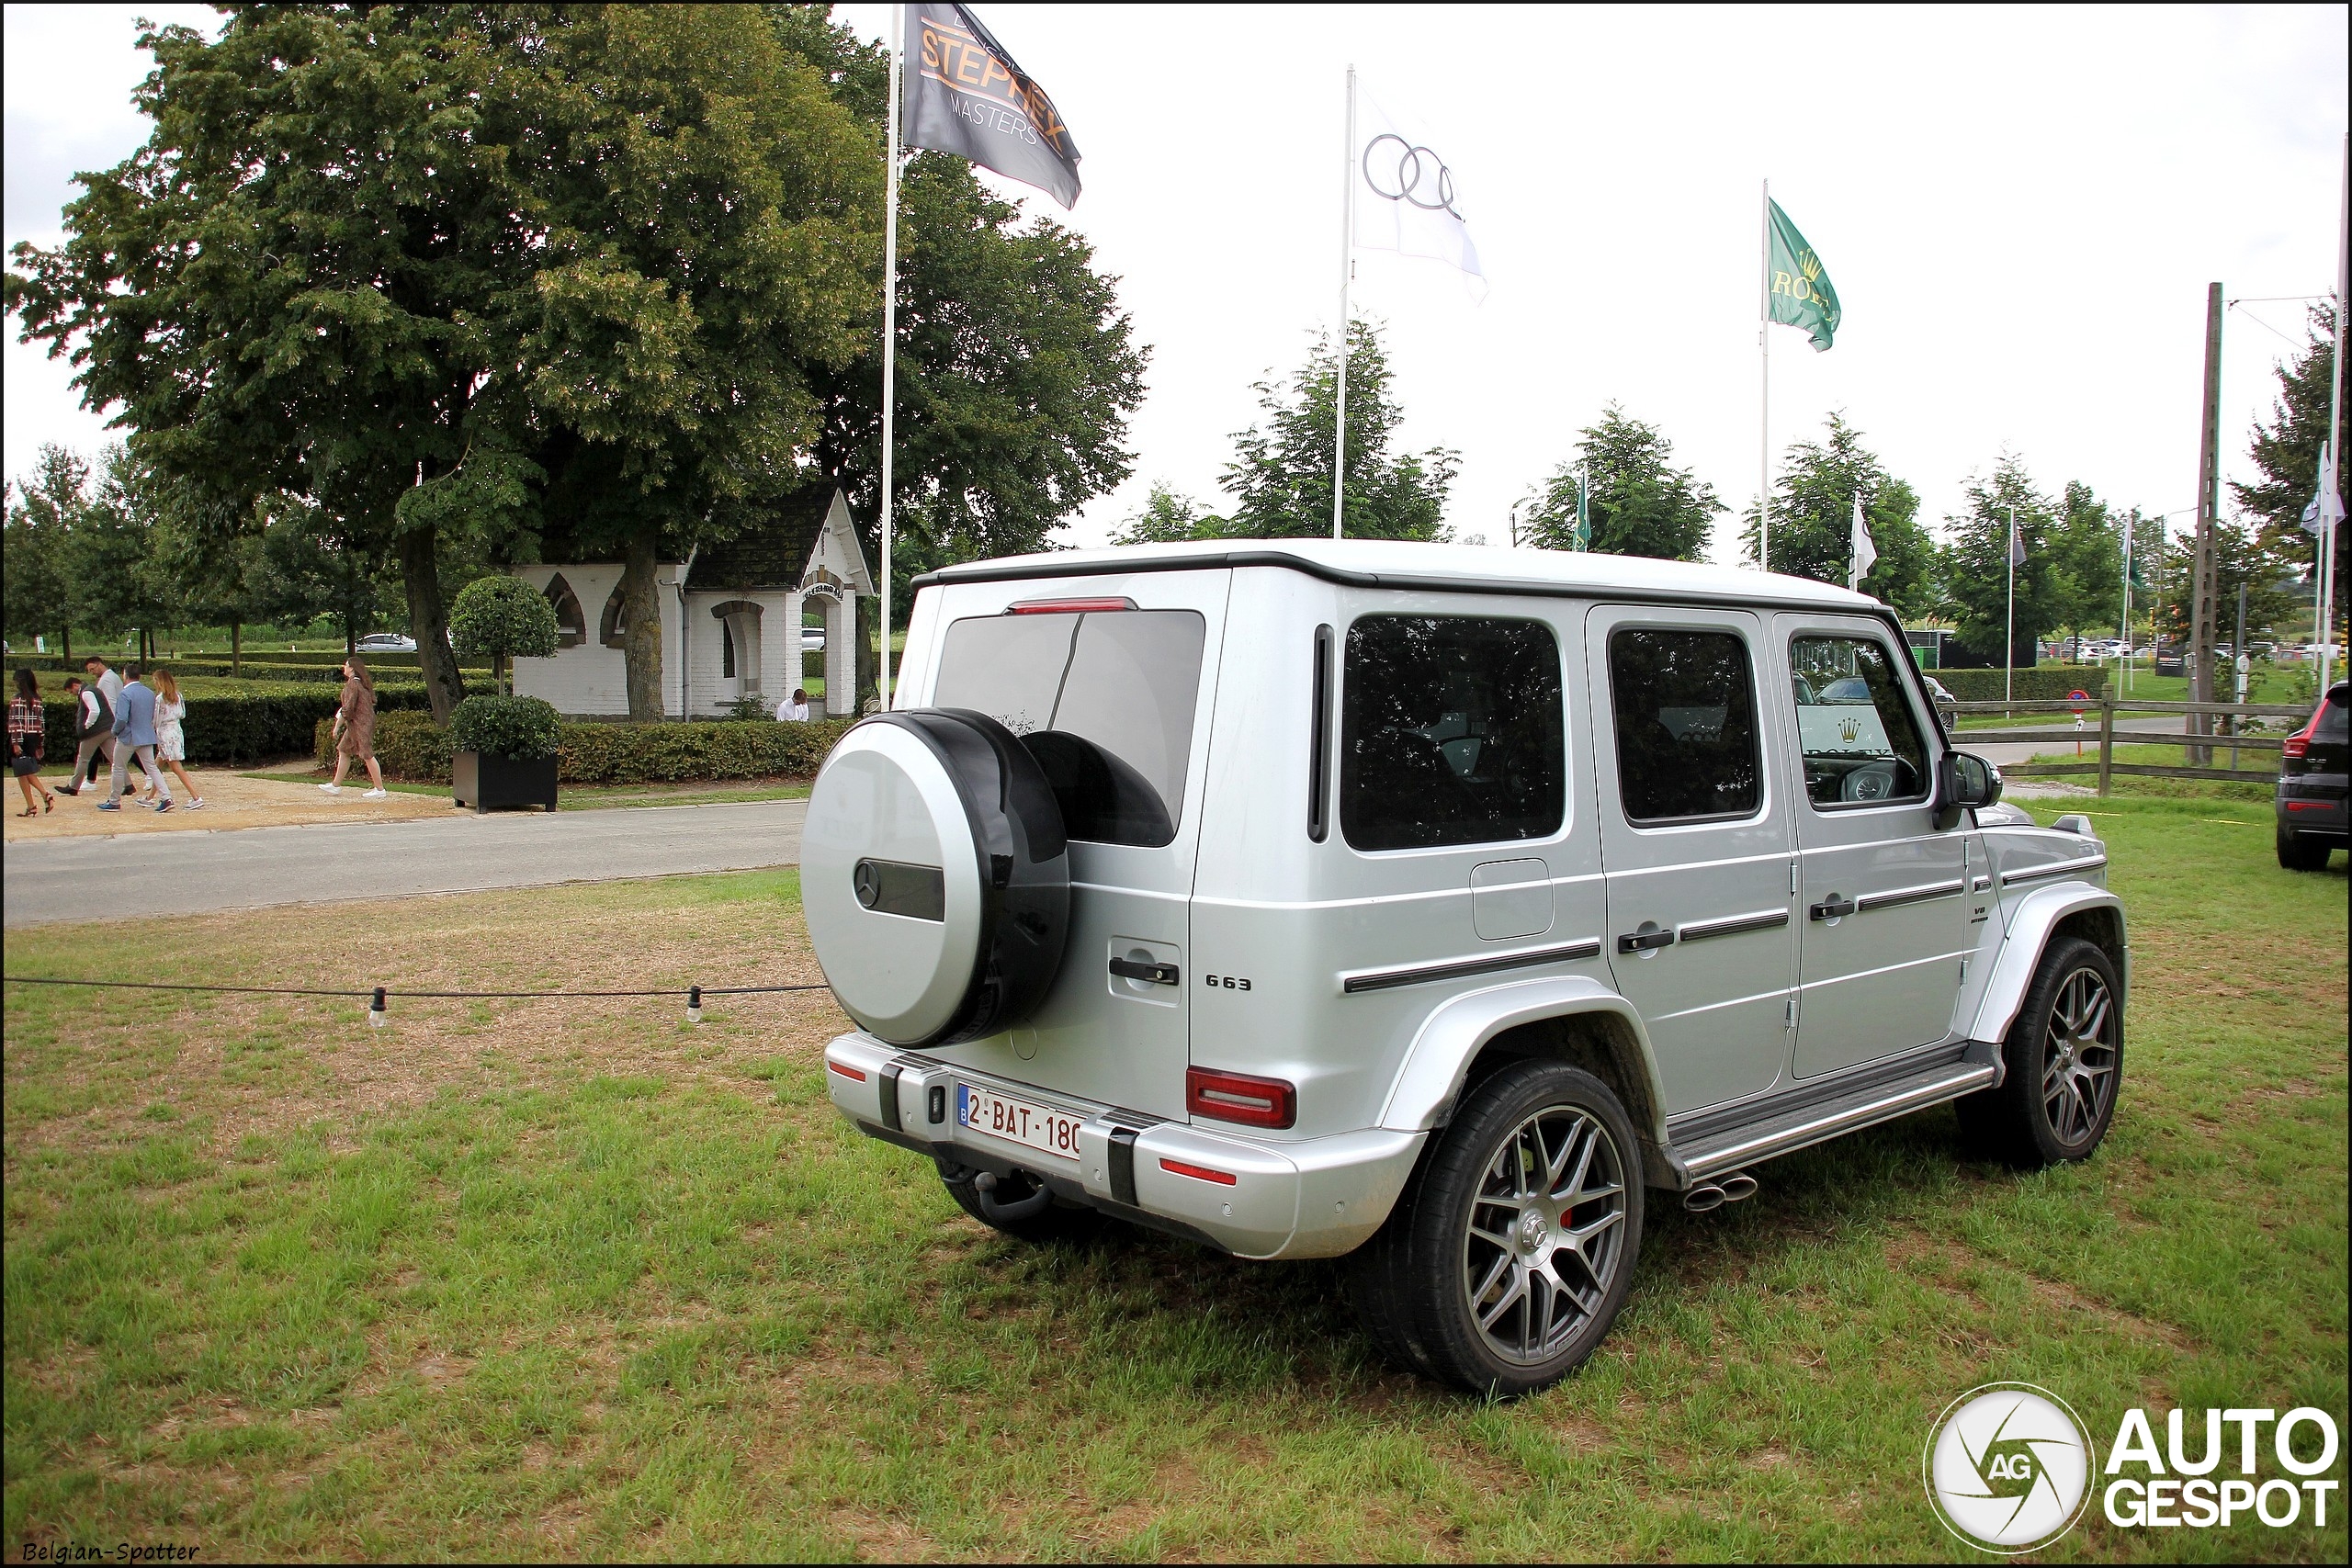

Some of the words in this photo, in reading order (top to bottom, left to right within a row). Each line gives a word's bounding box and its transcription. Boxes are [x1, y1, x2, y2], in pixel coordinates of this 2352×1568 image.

[950, 93, 1038, 146] MASTERS
[1205, 974, 1251, 991] G63
[960, 1108, 967, 1122] B
